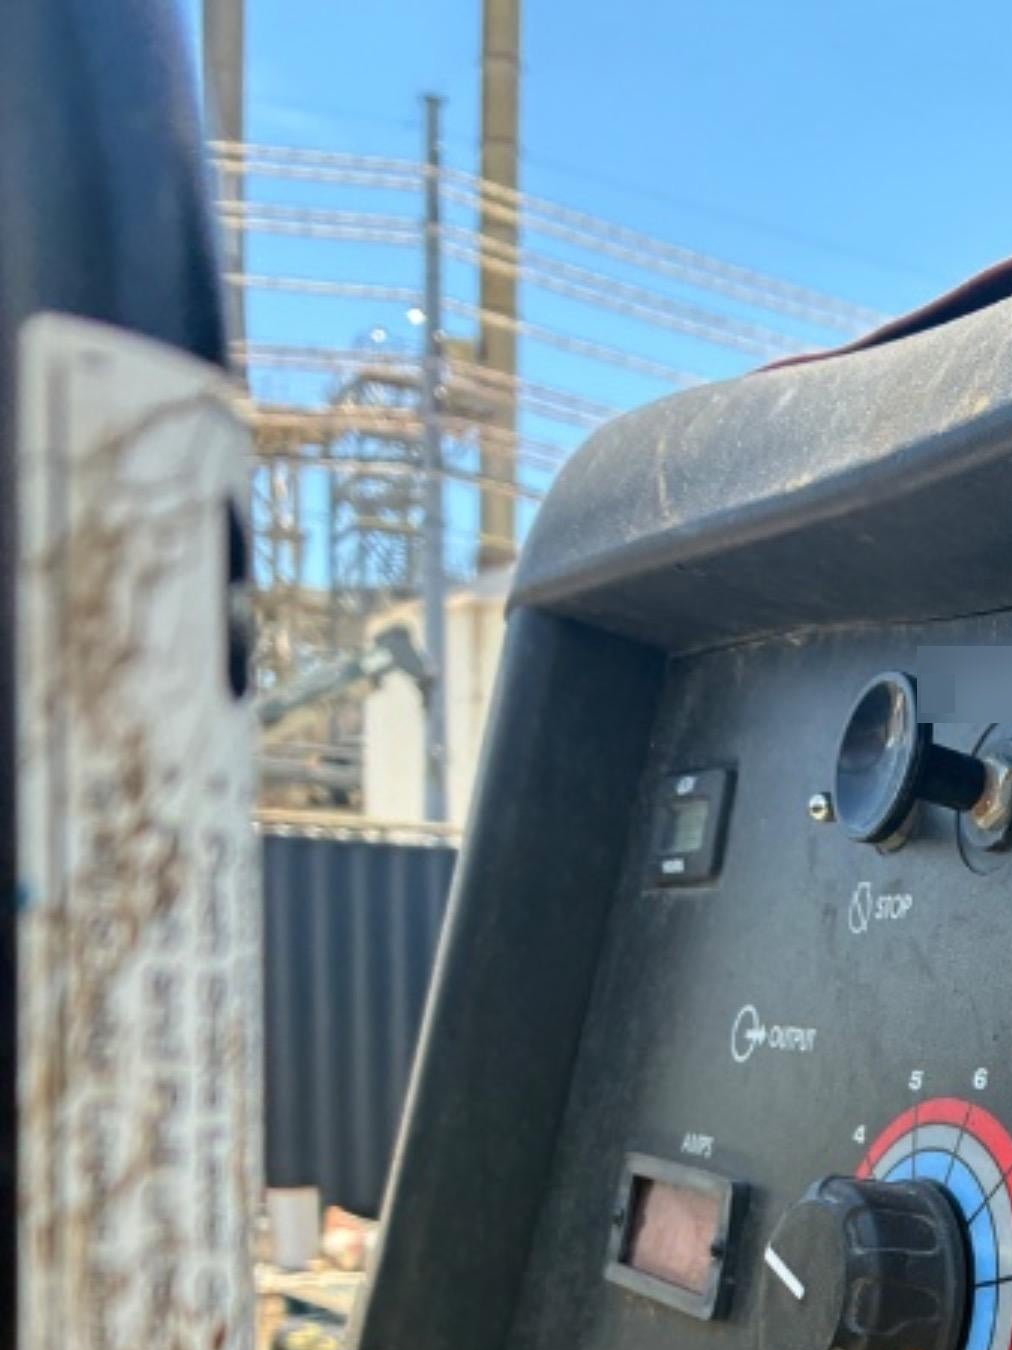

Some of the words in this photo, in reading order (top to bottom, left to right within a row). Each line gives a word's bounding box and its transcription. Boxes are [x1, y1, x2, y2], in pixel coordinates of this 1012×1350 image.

[874, 894, 912, 919] STOP
[908, 1070, 924, 1091] 5
[973, 1067, 988, 1090] 6
[853, 1125, 866, 1144] 4
